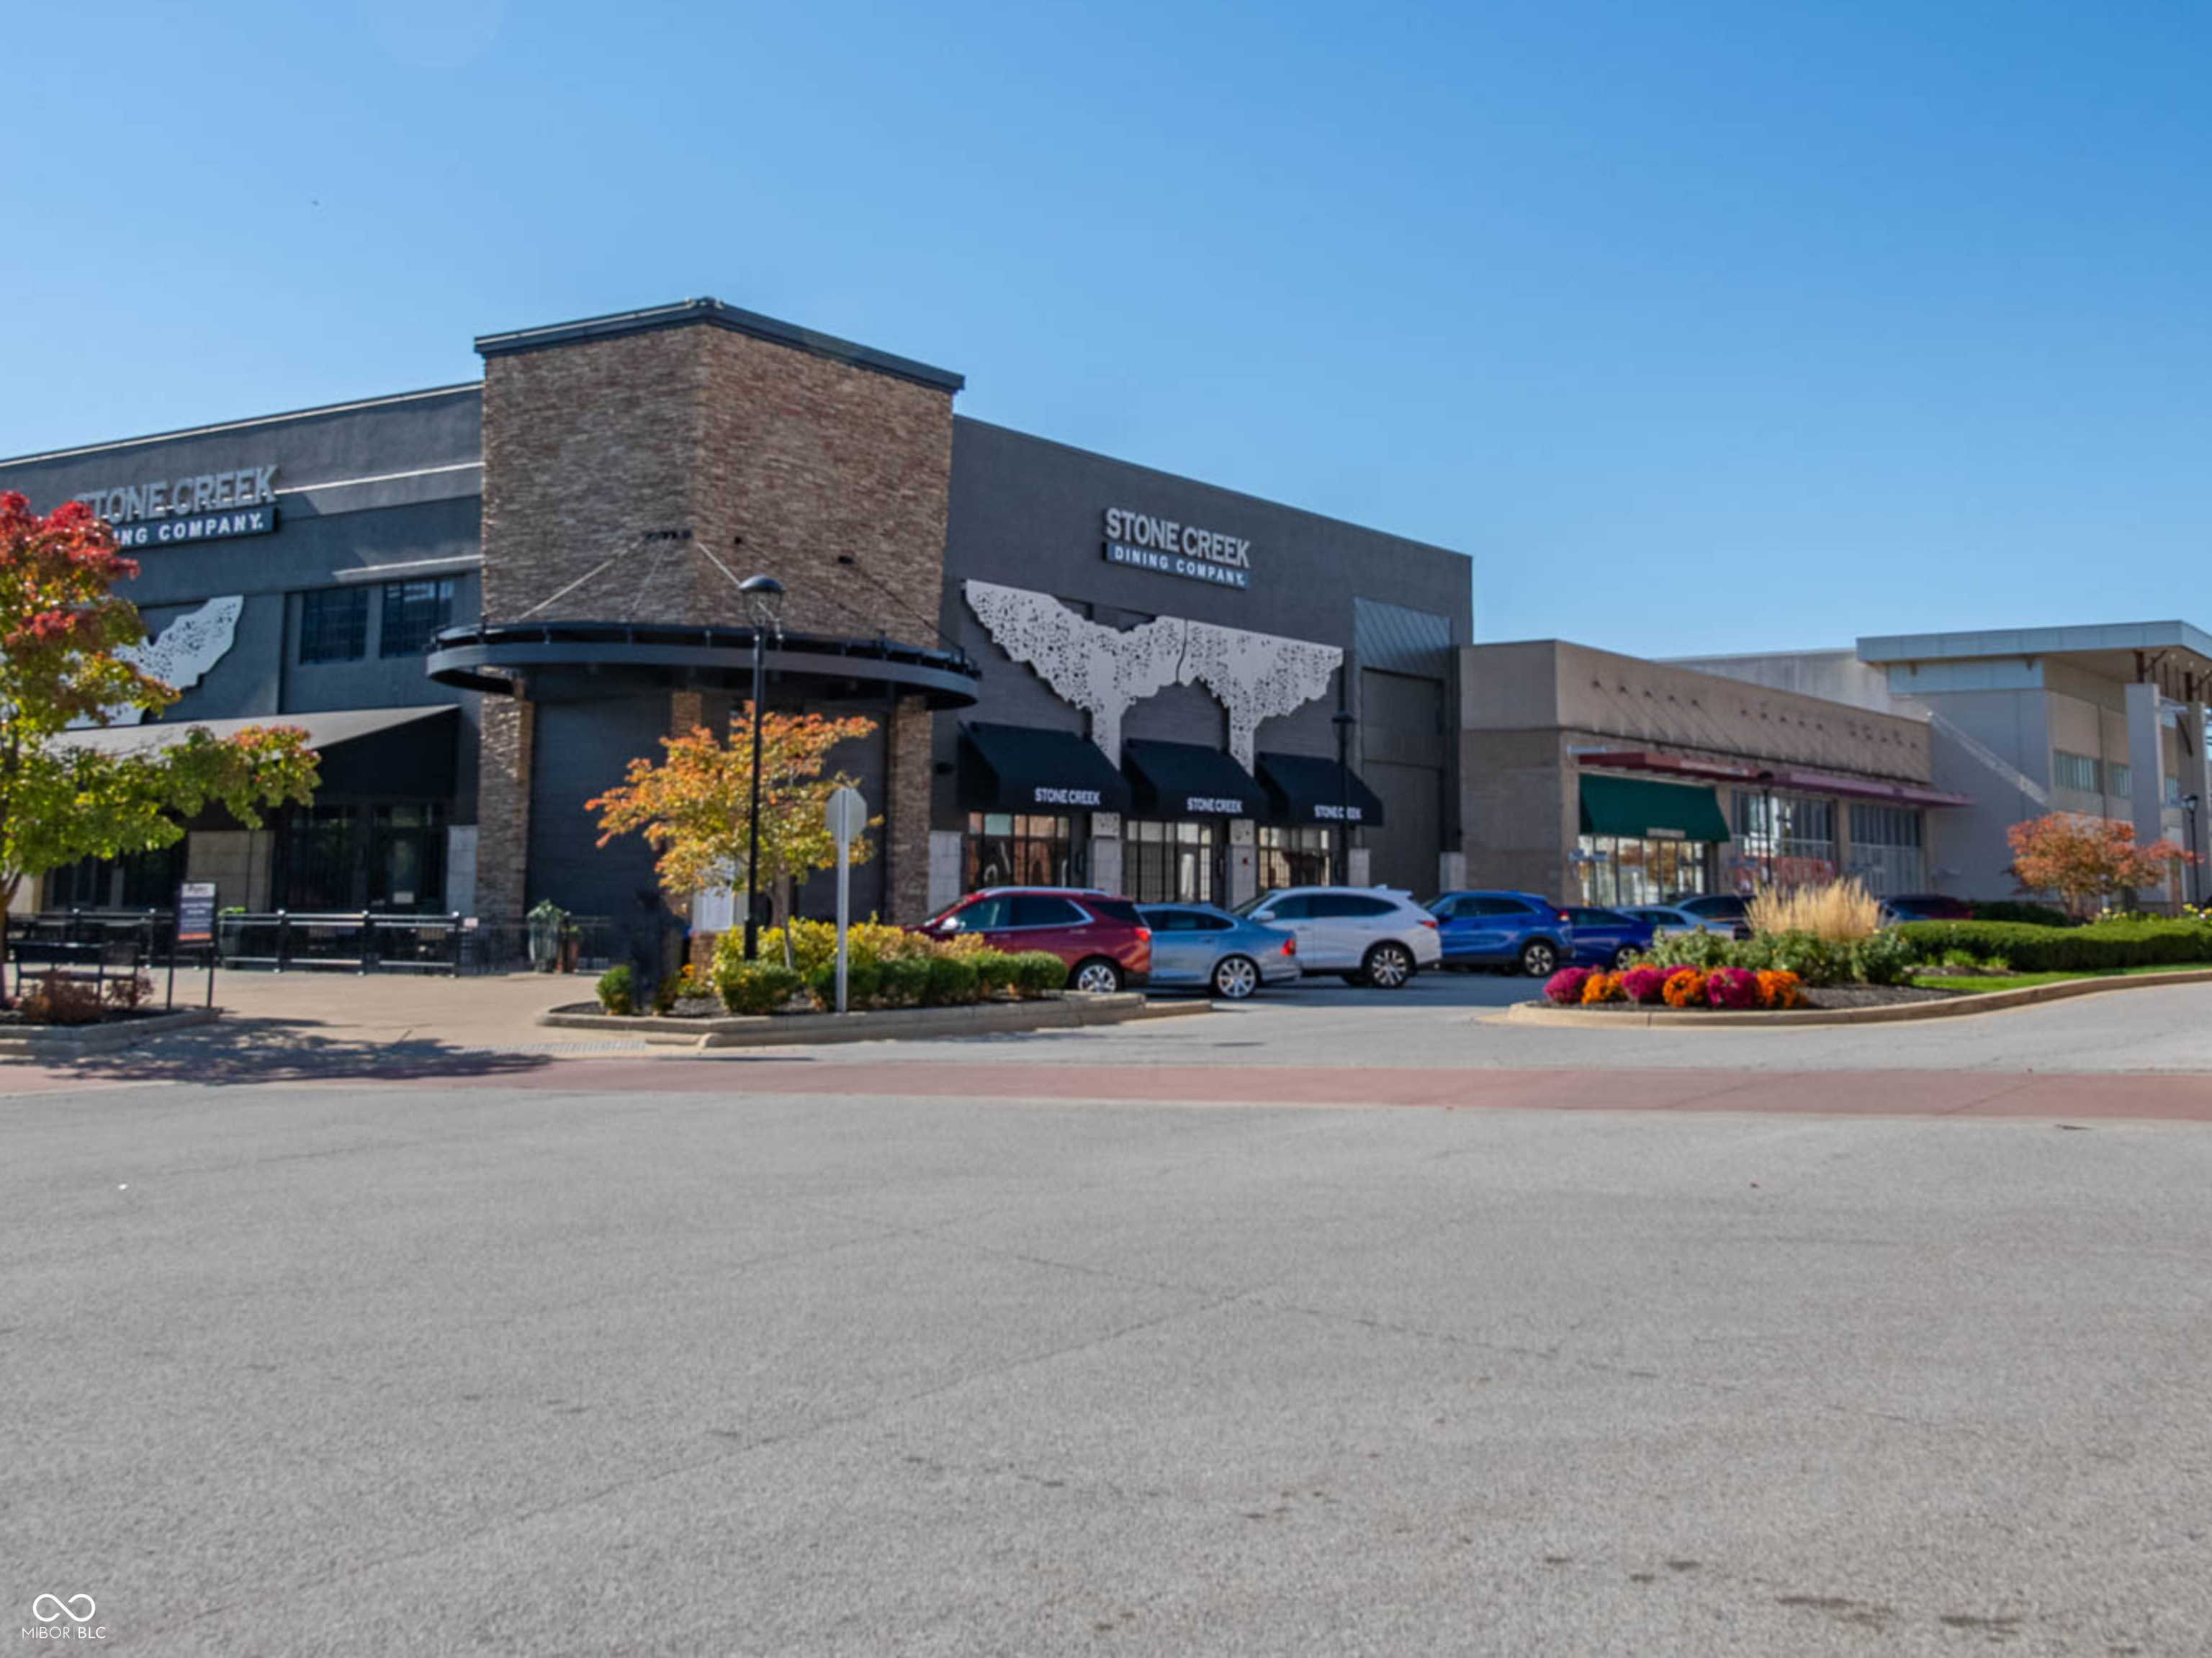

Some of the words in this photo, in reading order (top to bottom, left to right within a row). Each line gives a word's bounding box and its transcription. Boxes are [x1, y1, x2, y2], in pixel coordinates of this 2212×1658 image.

[172, 465, 276, 516] CREEK
[1106, 508, 1180, 553] STONE
[1182, 526, 1250, 568] CREEK
[1114, 546, 1169, 569] DINING
[1034, 788, 1068, 804] STONE
[1069, 790, 1100, 805] CREEK
[1187, 797, 1215, 812] STONE
[1215, 798, 1243, 814] CREEK
[1314, 804, 1338, 818] STONE
[1338, 806, 1362, 820] CEEK
